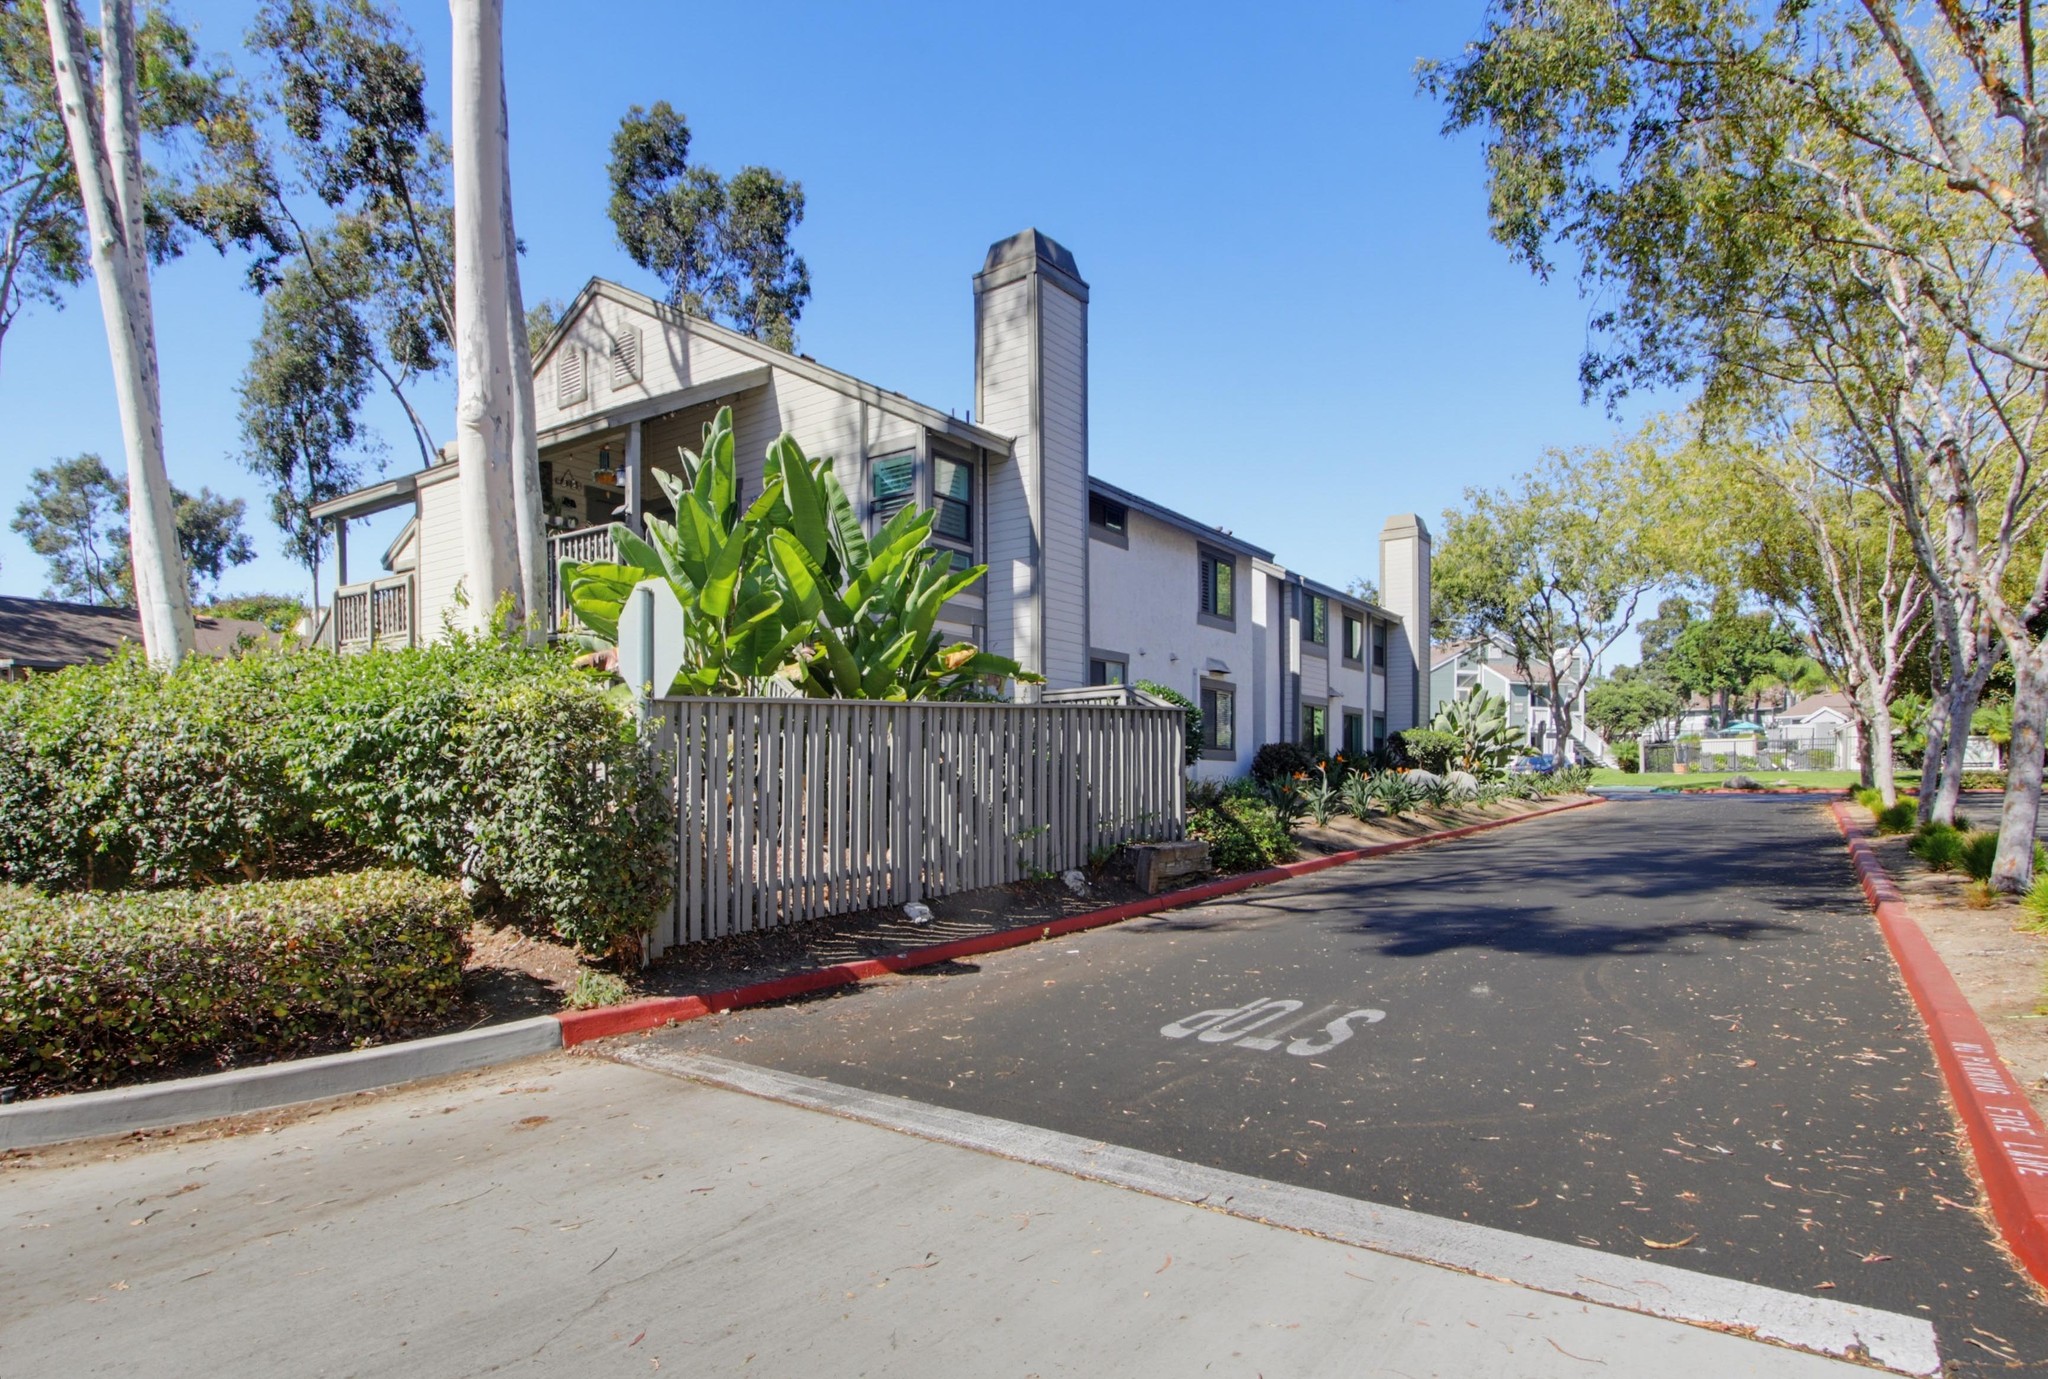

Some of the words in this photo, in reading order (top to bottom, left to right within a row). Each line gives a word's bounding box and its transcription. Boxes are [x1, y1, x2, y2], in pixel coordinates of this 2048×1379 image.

[1160, 997, 1387, 1056] STOP
[1951, 1041, 1985, 1053] NO
[1957, 1055, 2011, 1095] PARKING
[1985, 1105, 2037, 1136] FIRE
